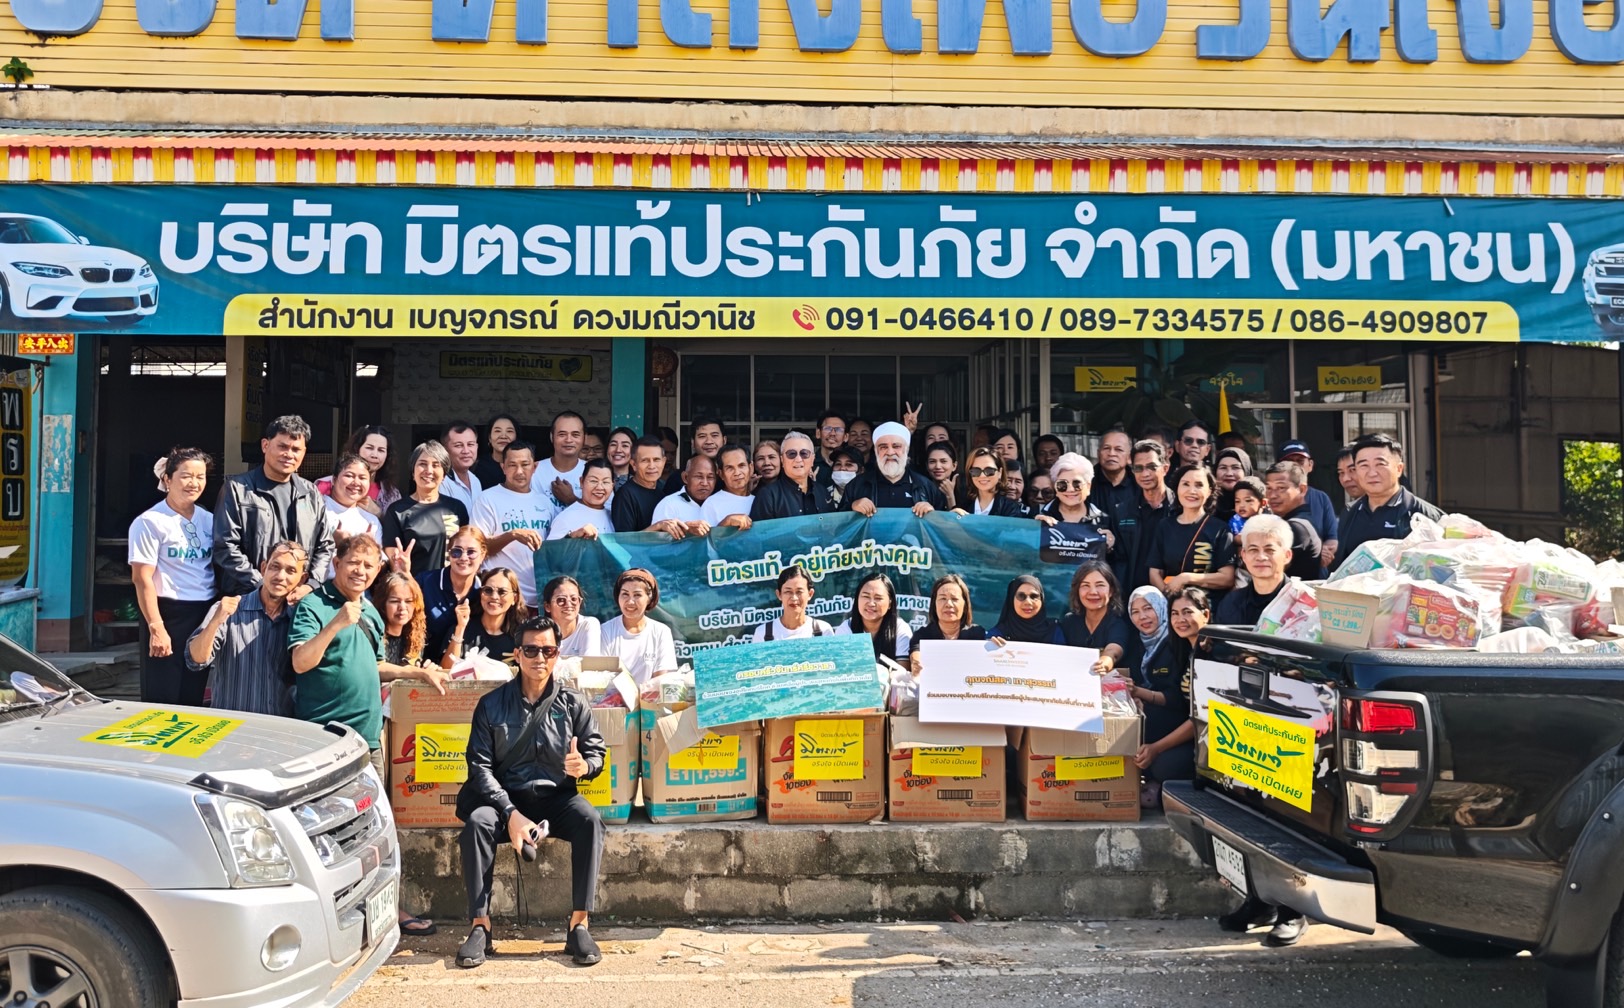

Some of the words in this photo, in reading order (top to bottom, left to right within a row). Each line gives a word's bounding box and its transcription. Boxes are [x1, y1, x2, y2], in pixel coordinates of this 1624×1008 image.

[160, 200, 382, 275] บริษัท
[405, 199, 1026, 279] มิตรแท้ประกันภัย
[1045, 201, 1250, 280] จำกัด
[1270, 218, 1575, 294] (มหาชน)
[258, 297, 393, 330] สำนักงาน
[409, 301, 558, 334] เบญจภรณ์
[573, 300, 756, 333] ดวงมณีวานิช
[826, 306, 1034, 332] 091-0466410
[1060, 307, 1264, 333] 089-7334575
[1290, 309, 1488, 335] 086-4909807
[710, 553, 780, 584] มิตรแท้
[701, 608, 741, 628] บริษัท
[1213, 708, 1306, 769] มิตรแท้
[1243, 718, 1307, 745] มิตรแท้ประกันภัย
[1230, 763, 1259, 781] จริงใจ
[1261, 775, 1303, 800] เปิดเผย
